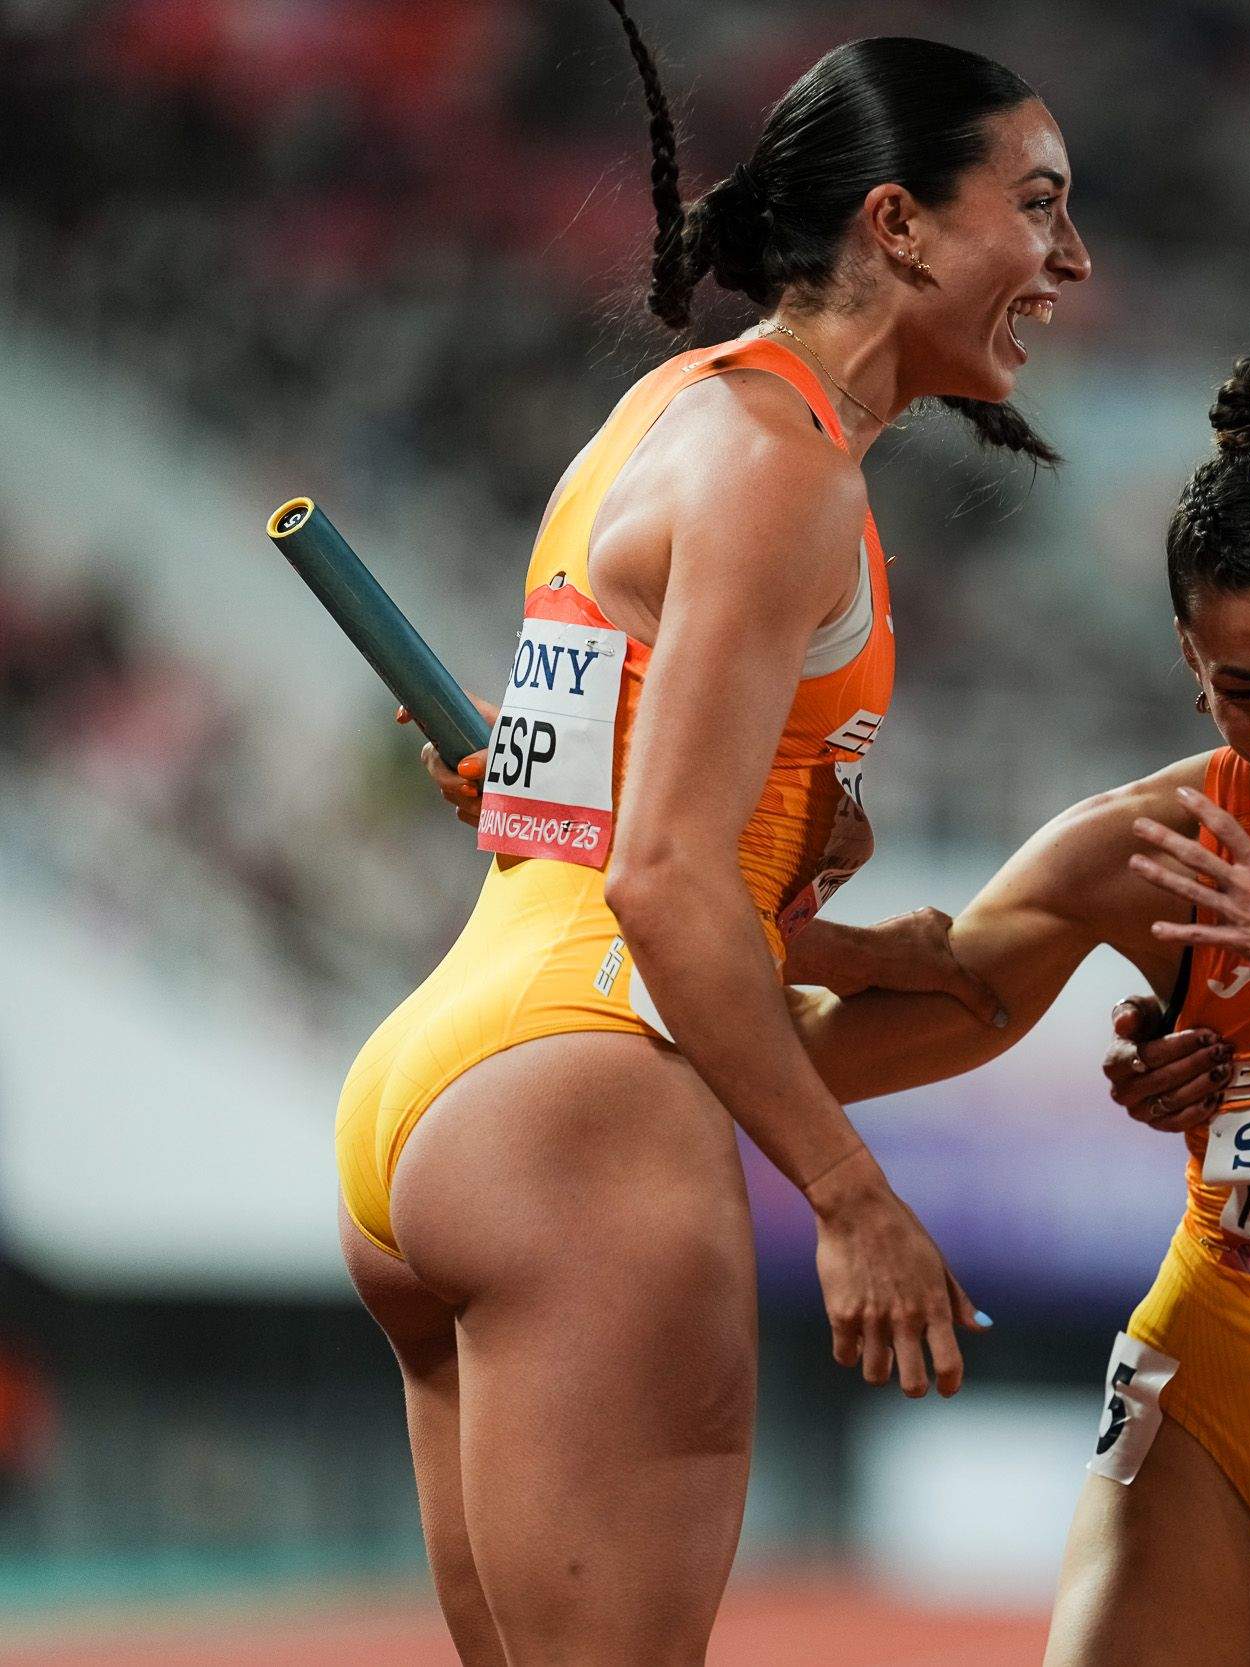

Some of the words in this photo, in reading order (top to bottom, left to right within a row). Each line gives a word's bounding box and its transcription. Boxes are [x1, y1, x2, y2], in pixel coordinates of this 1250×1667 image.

[511, 639, 599, 696] ONY
[487, 715, 556, 788] ESP
[571, 823, 601, 851] 25
[1096, 1361, 1137, 1455] 5
